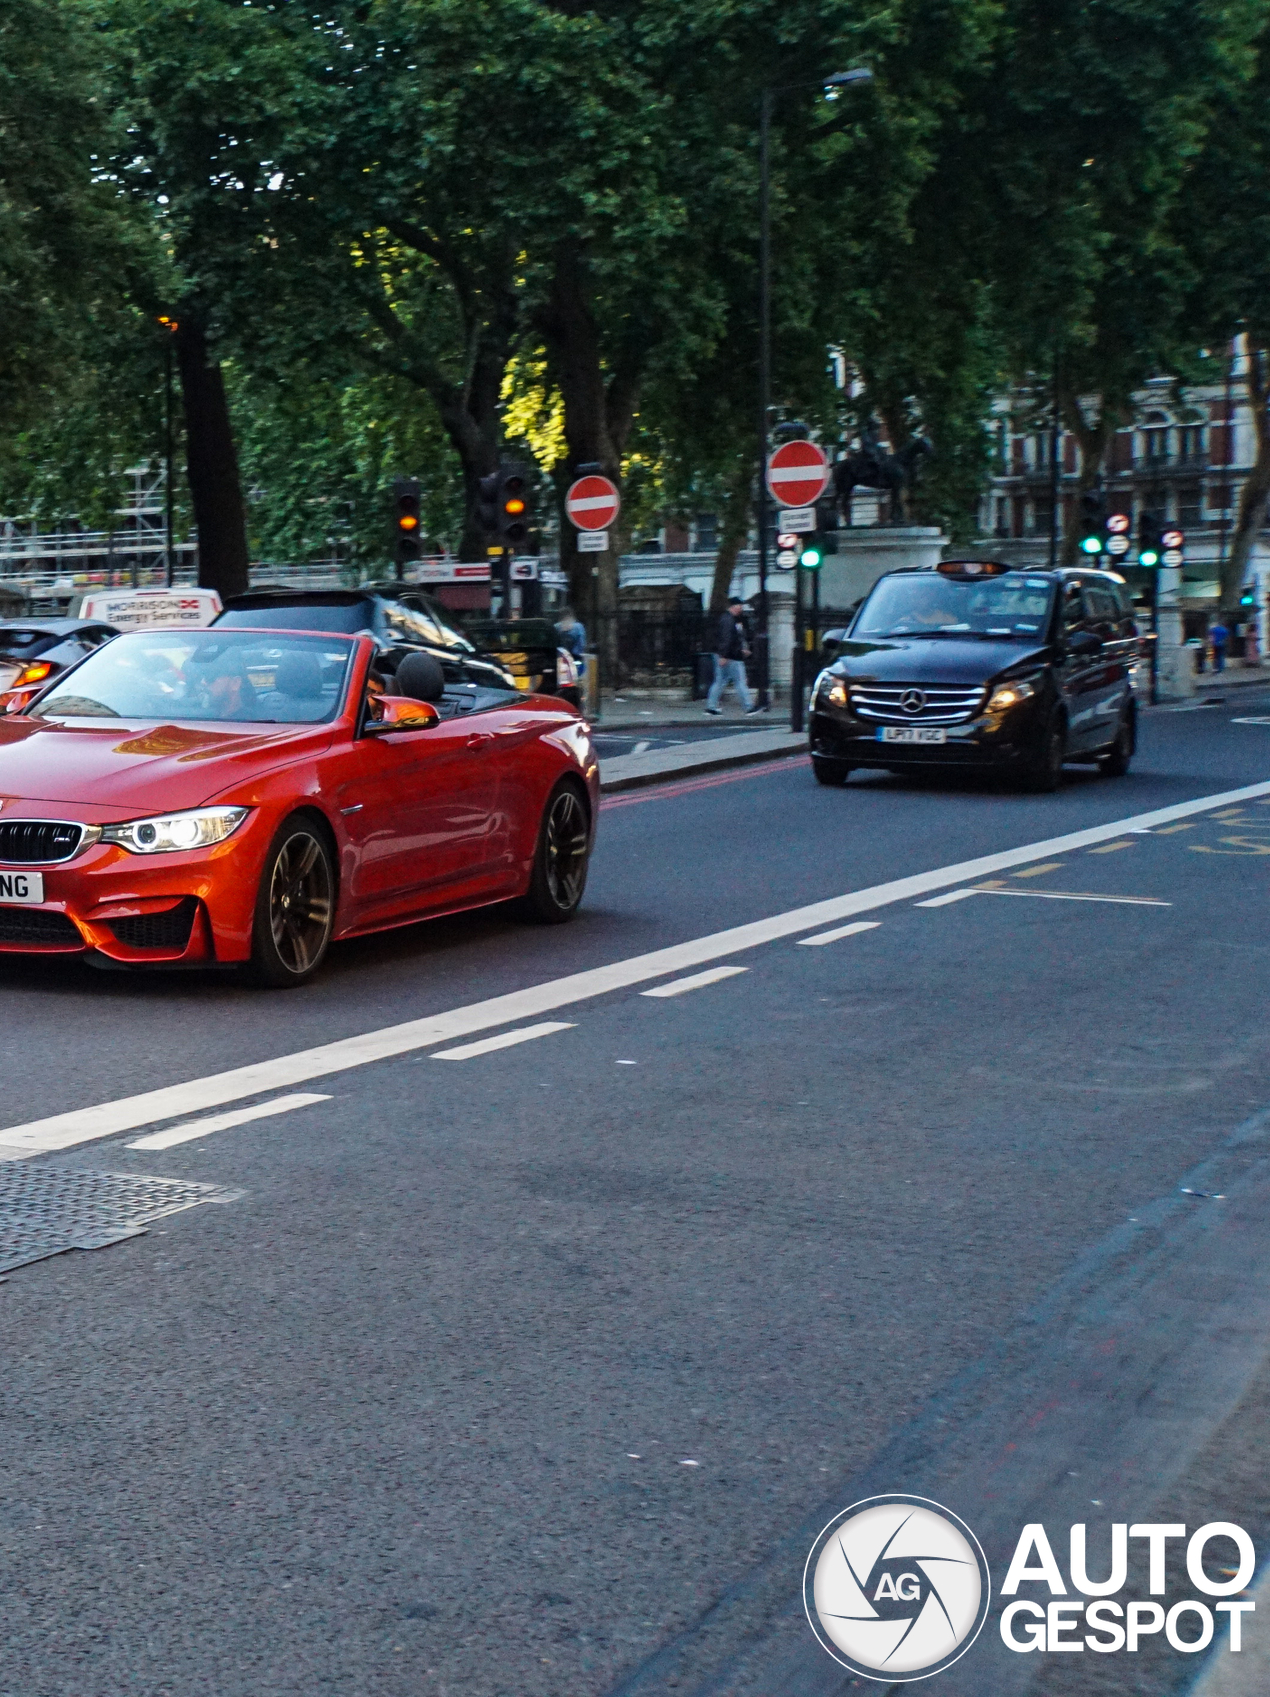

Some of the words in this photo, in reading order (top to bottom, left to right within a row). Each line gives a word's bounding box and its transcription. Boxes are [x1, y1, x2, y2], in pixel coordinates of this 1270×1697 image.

[107, 600, 179, 611] MORRISON
[108, 613, 148, 624] Energy
[150, 611, 201, 621] Services
